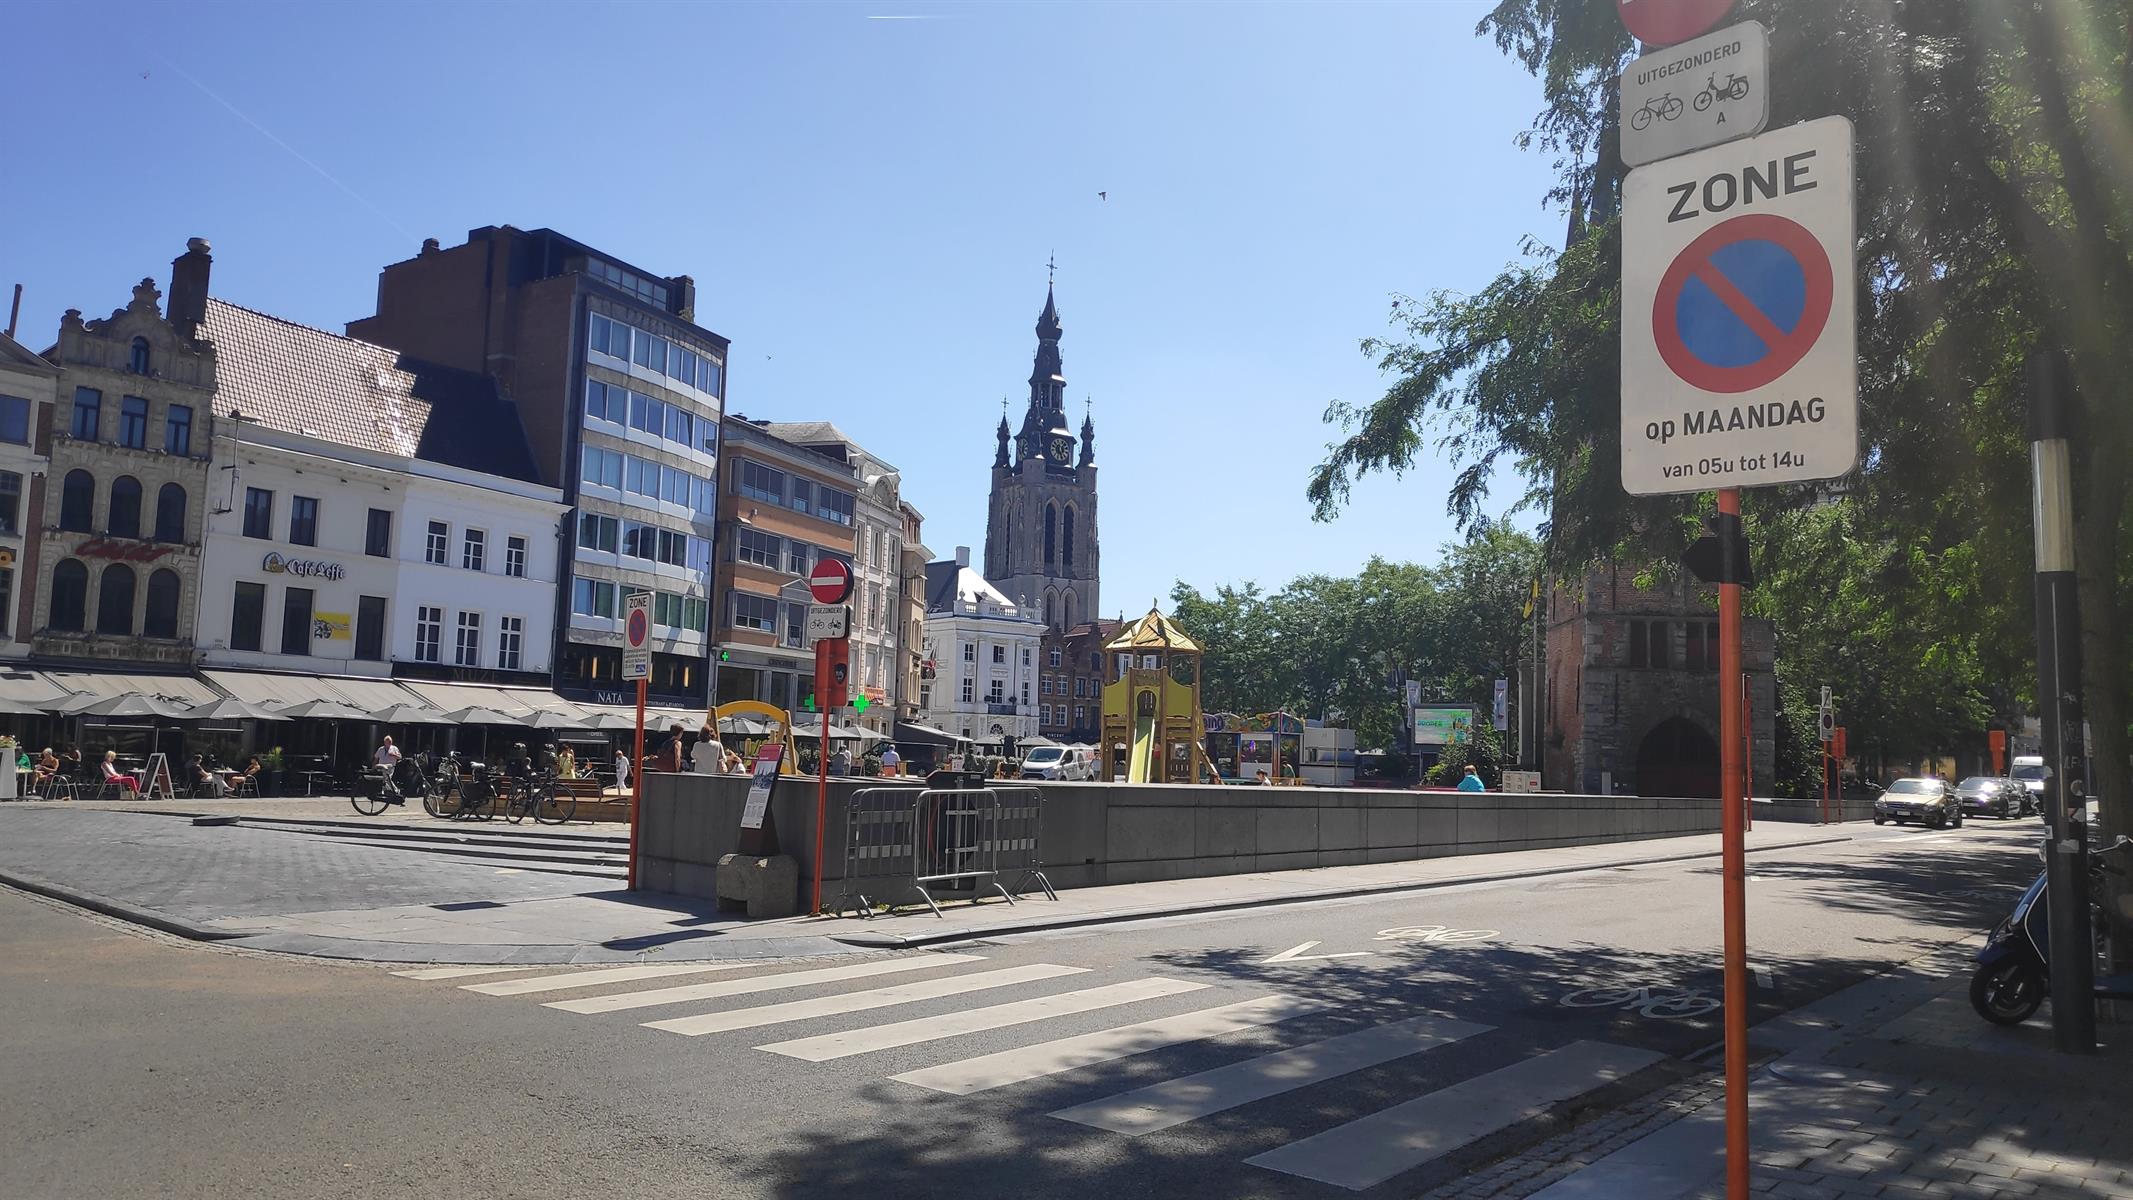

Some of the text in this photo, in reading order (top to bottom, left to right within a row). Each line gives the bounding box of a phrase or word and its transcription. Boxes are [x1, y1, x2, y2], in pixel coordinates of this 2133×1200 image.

[1638, 41, 1741, 85] UITGEZONDERD
[1717, 112, 1726, 124] A
[1667, 150, 1819, 223] ZONE
[1646, 398, 1825, 444] op MAANDAG
[1663, 451, 1805, 478] van 05u tot 14u
[285, 558, 345, 581] Café Leffe
[629, 597, 647, 608] ZONE
[598, 692, 623, 704] NATA
